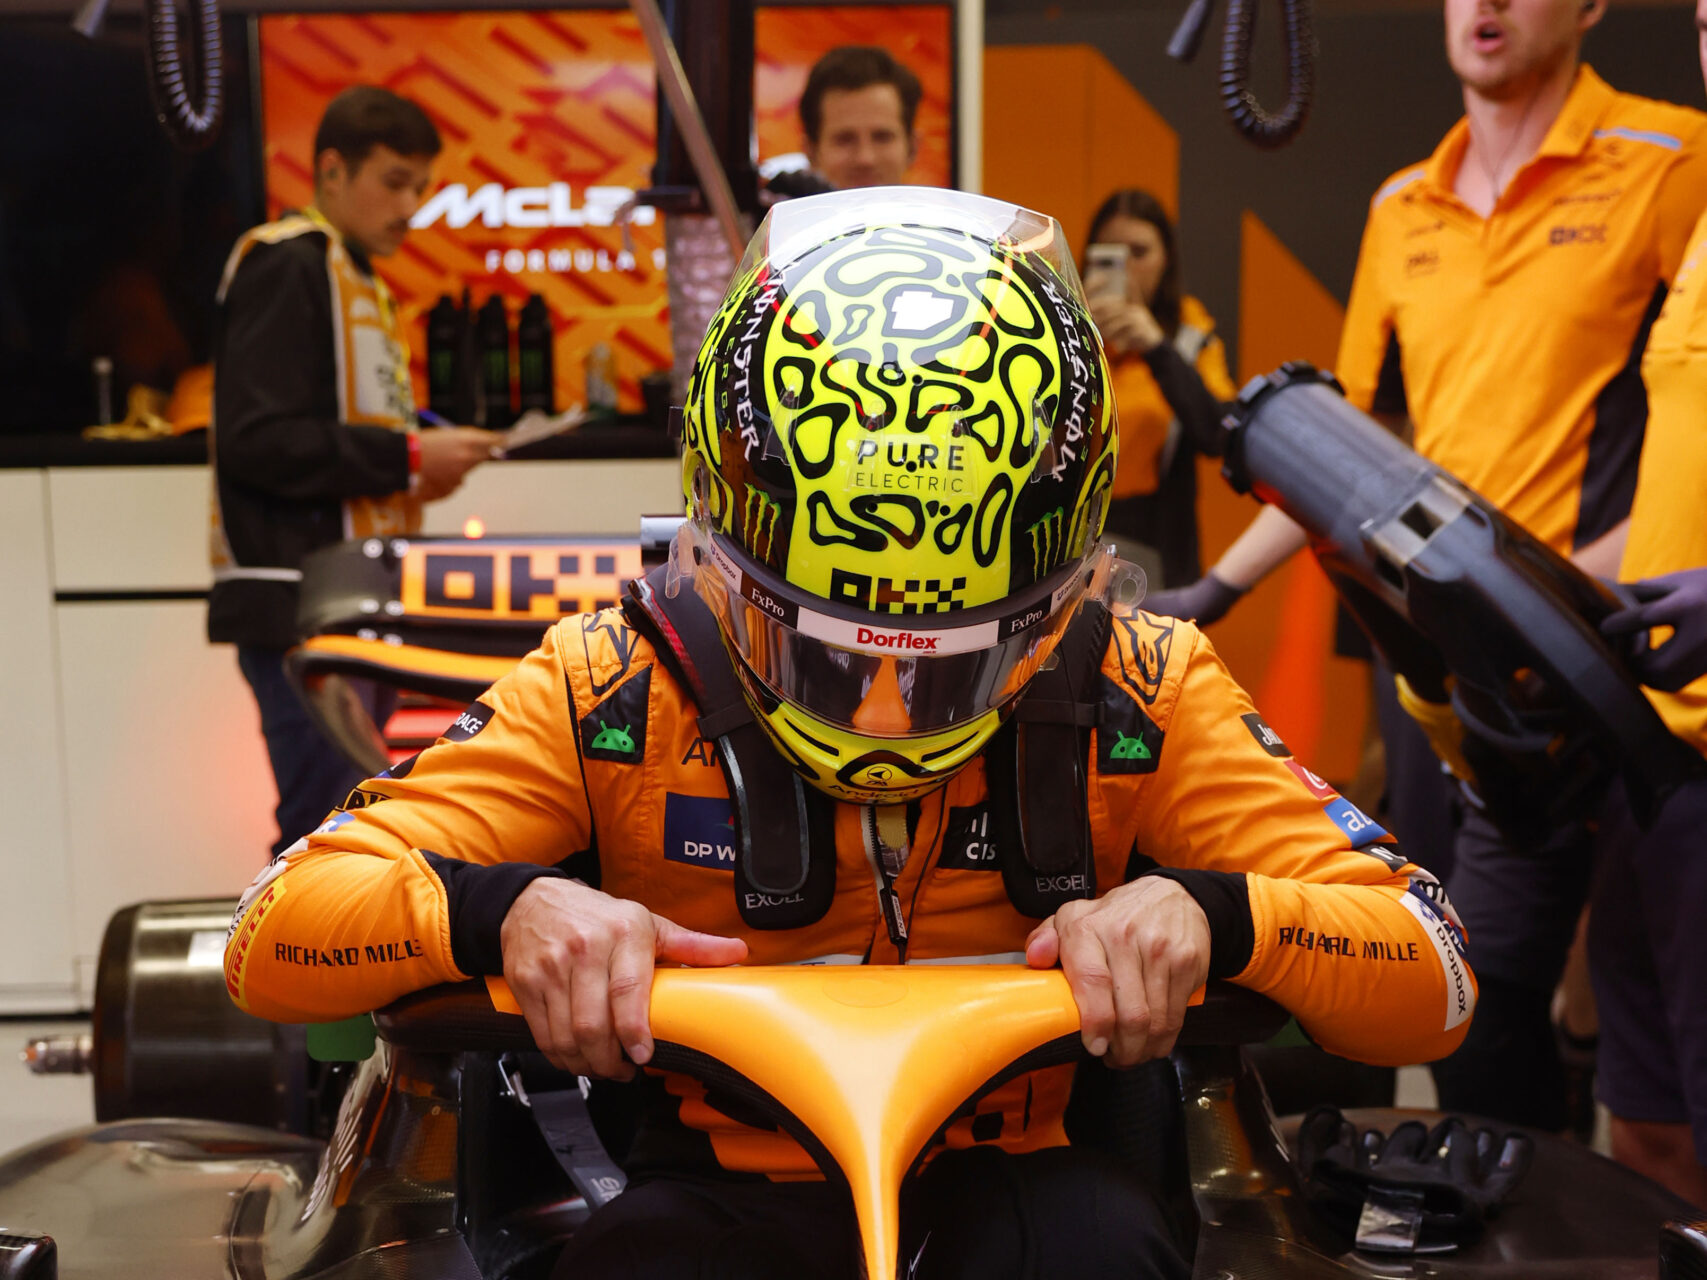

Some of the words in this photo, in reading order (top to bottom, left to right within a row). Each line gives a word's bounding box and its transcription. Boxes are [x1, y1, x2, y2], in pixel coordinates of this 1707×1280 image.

[485, 249, 636, 273] FORMULA
[857, 439, 965, 471] PURE
[855, 472, 964, 493] ELECTRIC
[751, 587, 786, 618] FxPro
[1010, 608, 1044, 633] FxPro
[856, 627, 938, 650] Dorflex
[684, 840, 713, 859] DP
[966, 842, 996, 860] CIS
[1035, 874, 1092, 893] EXGEL
[275, 941, 359, 968] RICHARD
[364, 938, 424, 965] MILLE
[1278, 926, 1356, 958] RICHARD
[1362, 940, 1420, 962] MILLE
[1436, 925, 1467, 1016] Dropbox
